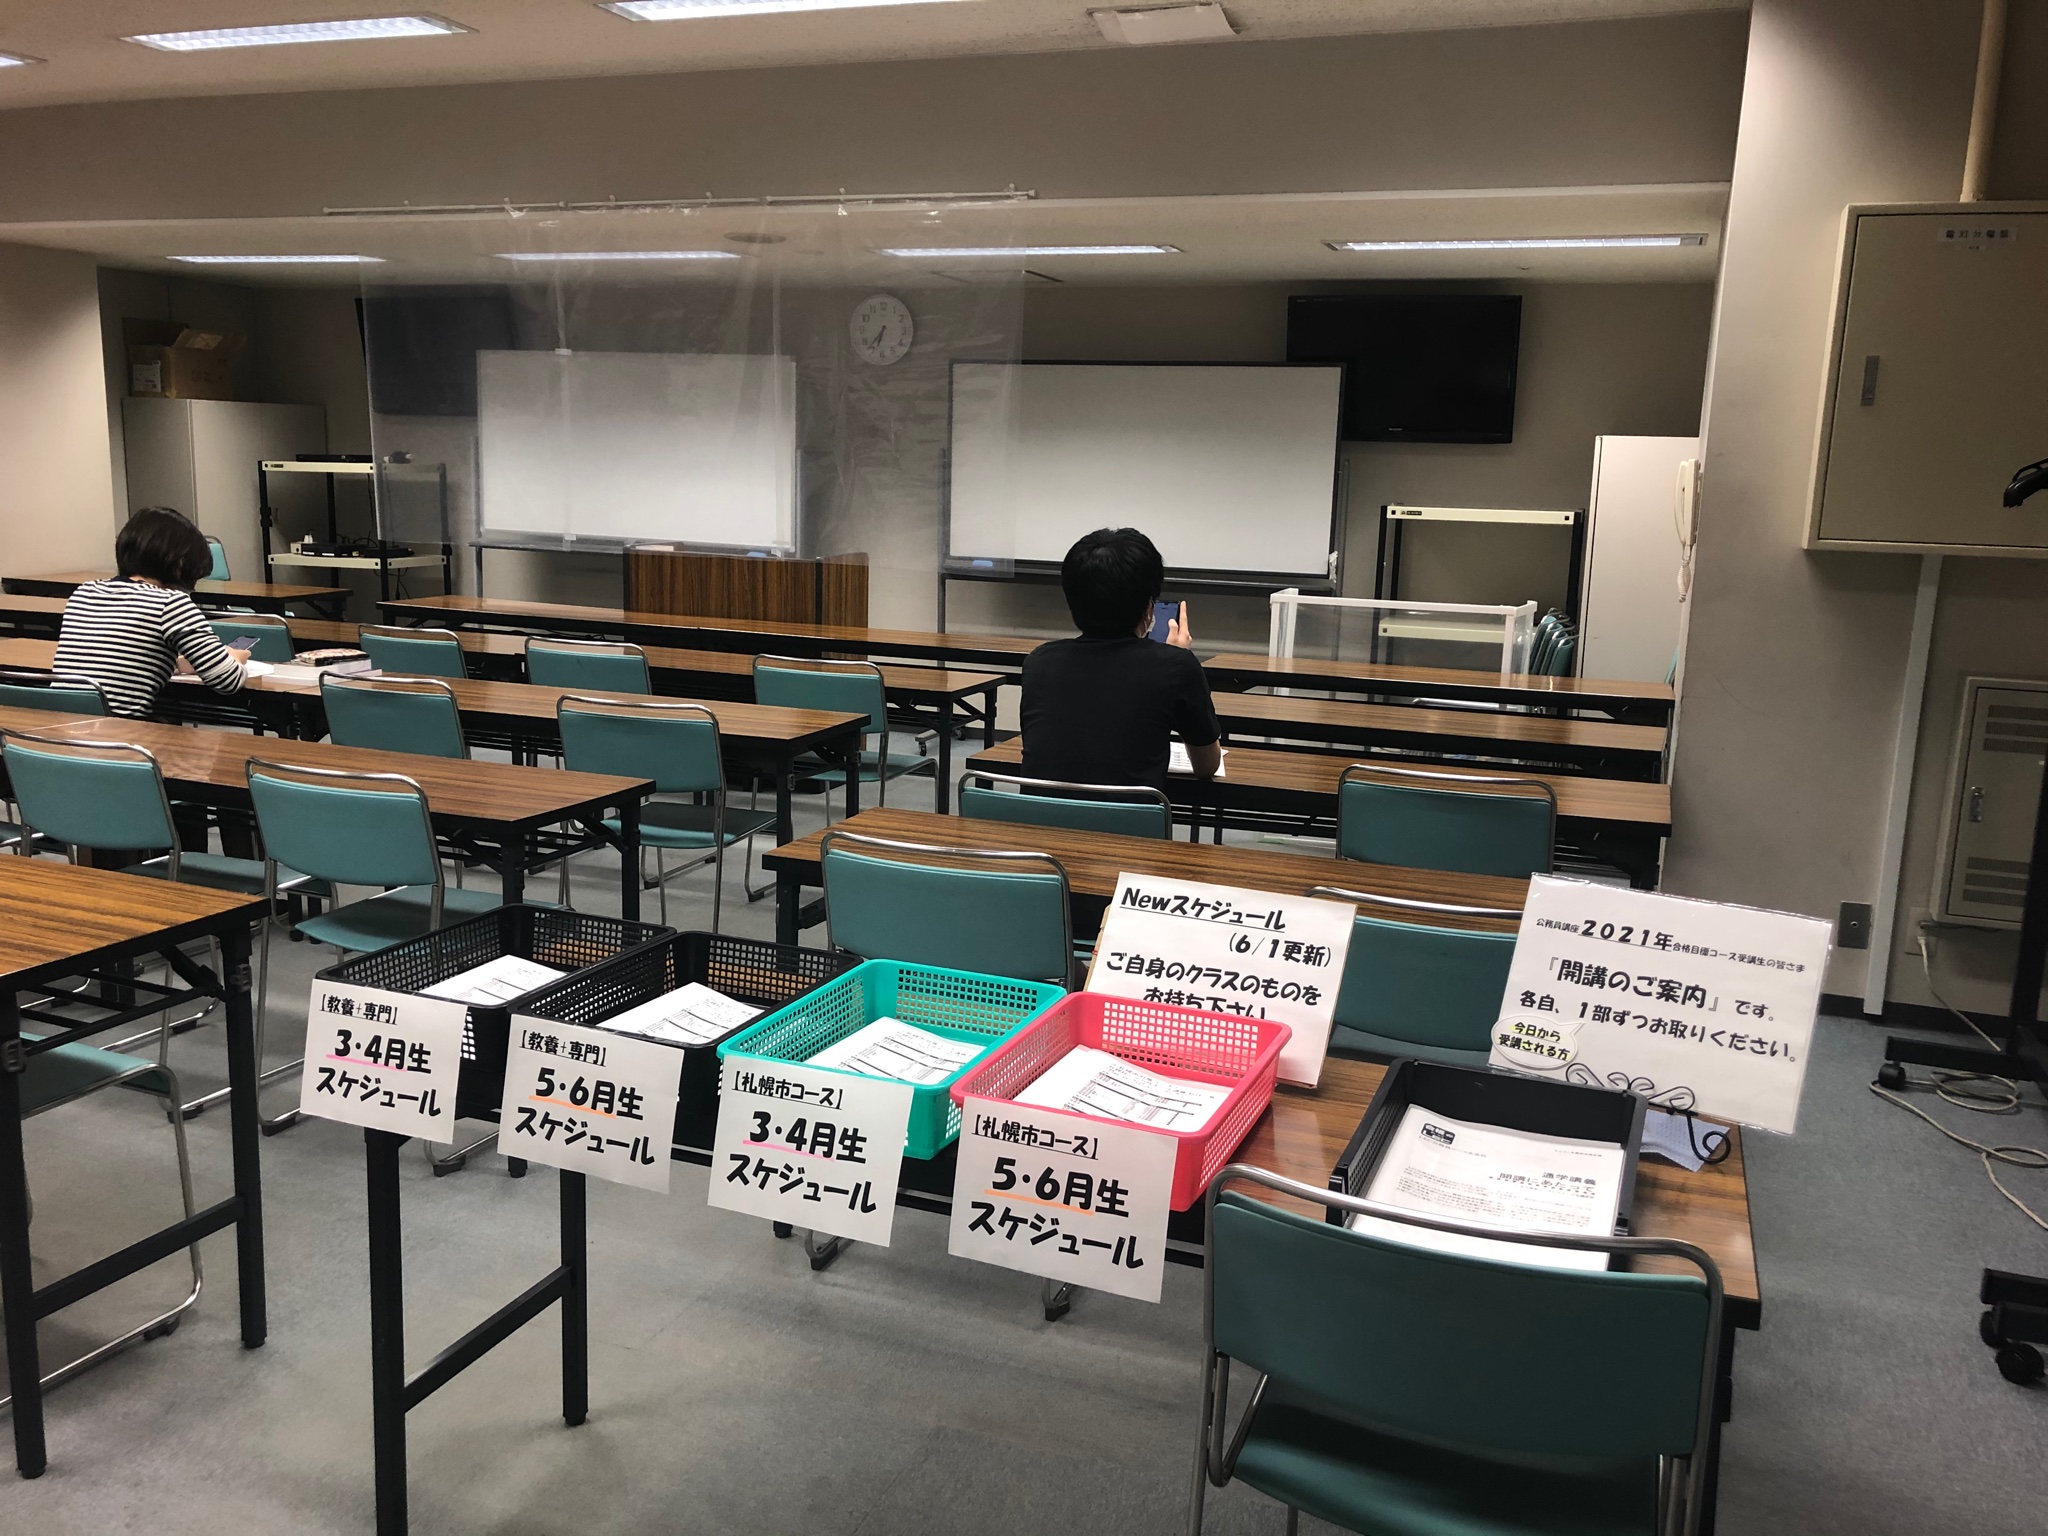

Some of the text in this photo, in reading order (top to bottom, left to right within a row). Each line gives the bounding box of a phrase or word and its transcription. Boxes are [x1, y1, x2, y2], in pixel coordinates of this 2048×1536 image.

[1120, 886, 1286, 931] Newスケジュール
[1229, 932, 1332, 968] (6/1更新)
[1106, 951, 1322, 1006] ご自身のクラスのものを
[333, 1028, 432, 1075] 3・4月生
[1497, 1033, 1571, 1062] 受講される方
[1513, 1021, 1562, 1043] 今日から
[315, 1066, 442, 1117] スケジュール
[535, 1066, 644, 1121] 5・6月生
[732, 1070, 843, 1110] 【札幌市コース】
[514, 1105, 656, 1166] スケジュール
[749, 1110, 868, 1165] 3・4月生
[972, 1114, 1099, 1160] 【札幌市コース】
[726, 1153, 877, 1214] スケジュール
[991, 1156, 1129, 1218] 5・6月生
[967, 1200, 1145, 1269] スケジュール
